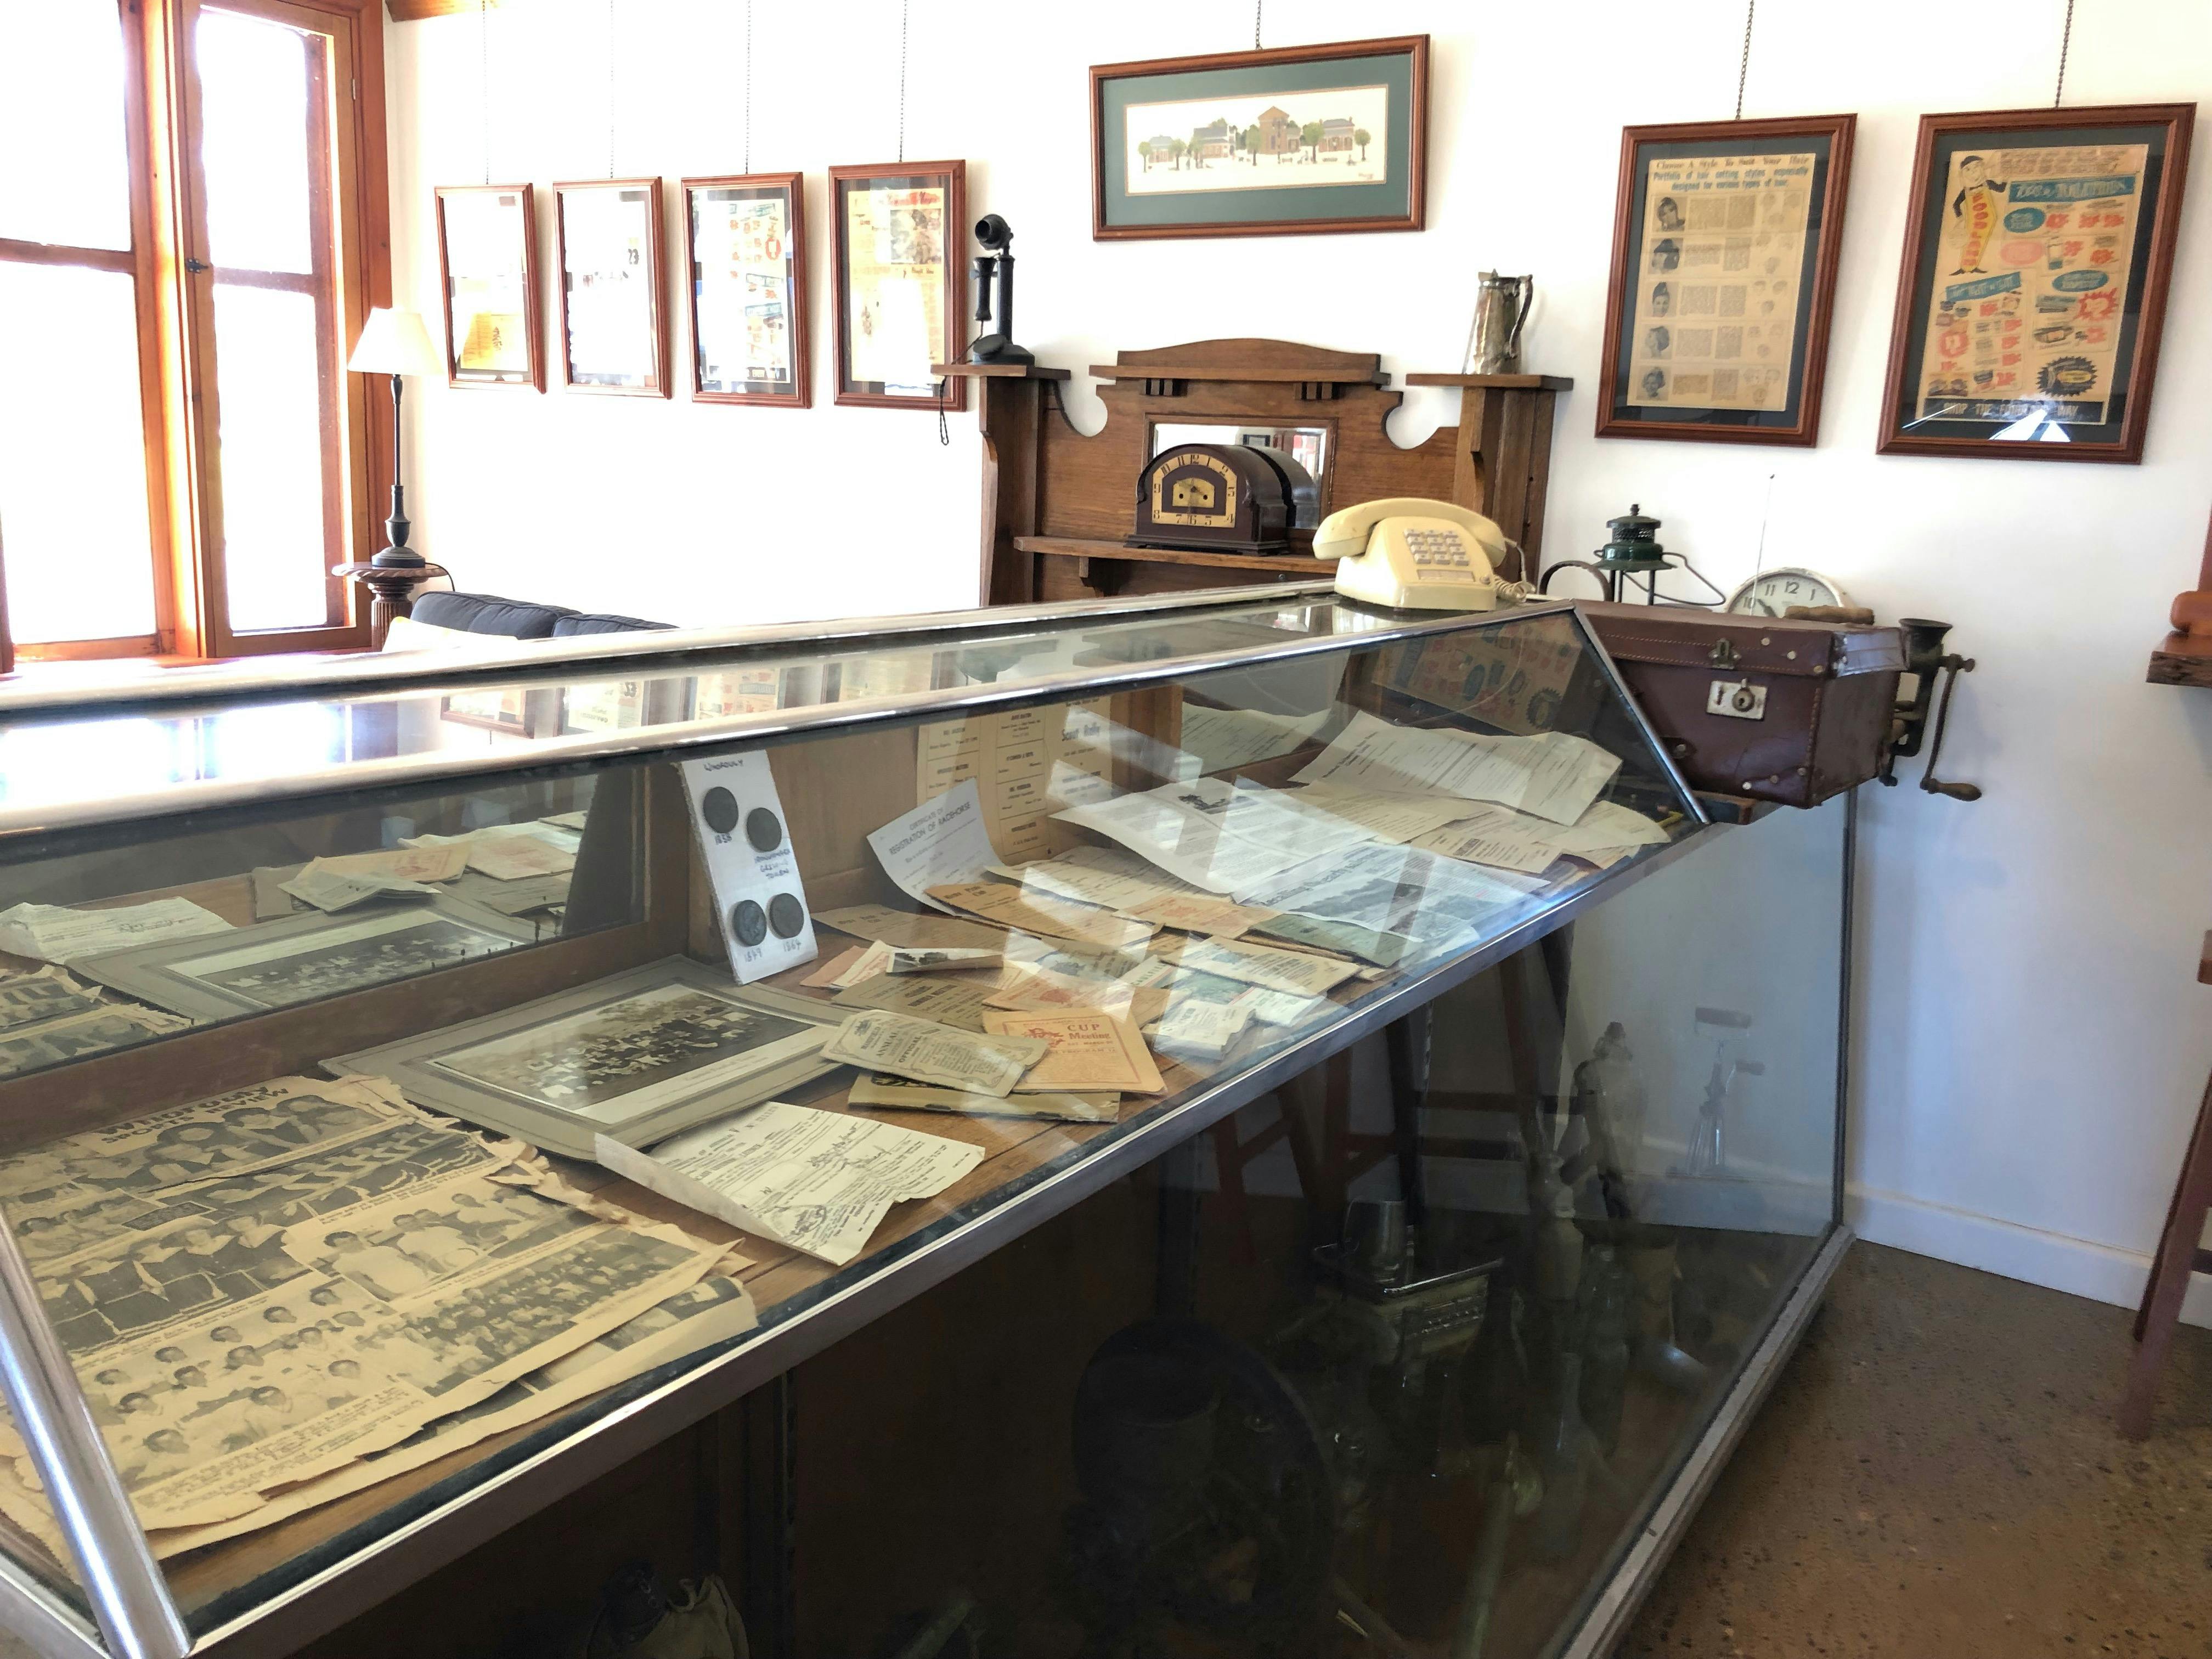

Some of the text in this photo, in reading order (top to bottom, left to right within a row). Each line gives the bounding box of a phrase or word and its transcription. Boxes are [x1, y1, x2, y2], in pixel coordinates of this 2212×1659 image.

[1190, 454, 1199, 465] 12
[1154, 483, 1161, 493] 9
[1153, 510, 1160, 519] 8
[1176, 514, 1182, 524] 7
[1190, 515, 1197, 525] 6
[1764, 584, 1776, 596] 11
[1785, 581, 1799, 594] 12
[1809, 589, 1816, 601] 1
[889, 829, 927, 856] REGISTRATION
[927, 821, 936, 832] OF
[938, 801, 972, 825] RACEHORSE
[1066, 1023, 1101, 1032] CUP
[876, 1031, 899, 1058] ANNUAL
[899, 1035, 923, 1063] OFFICIAL
[101, 1088, 289, 1144] SPORTS REVIEW
